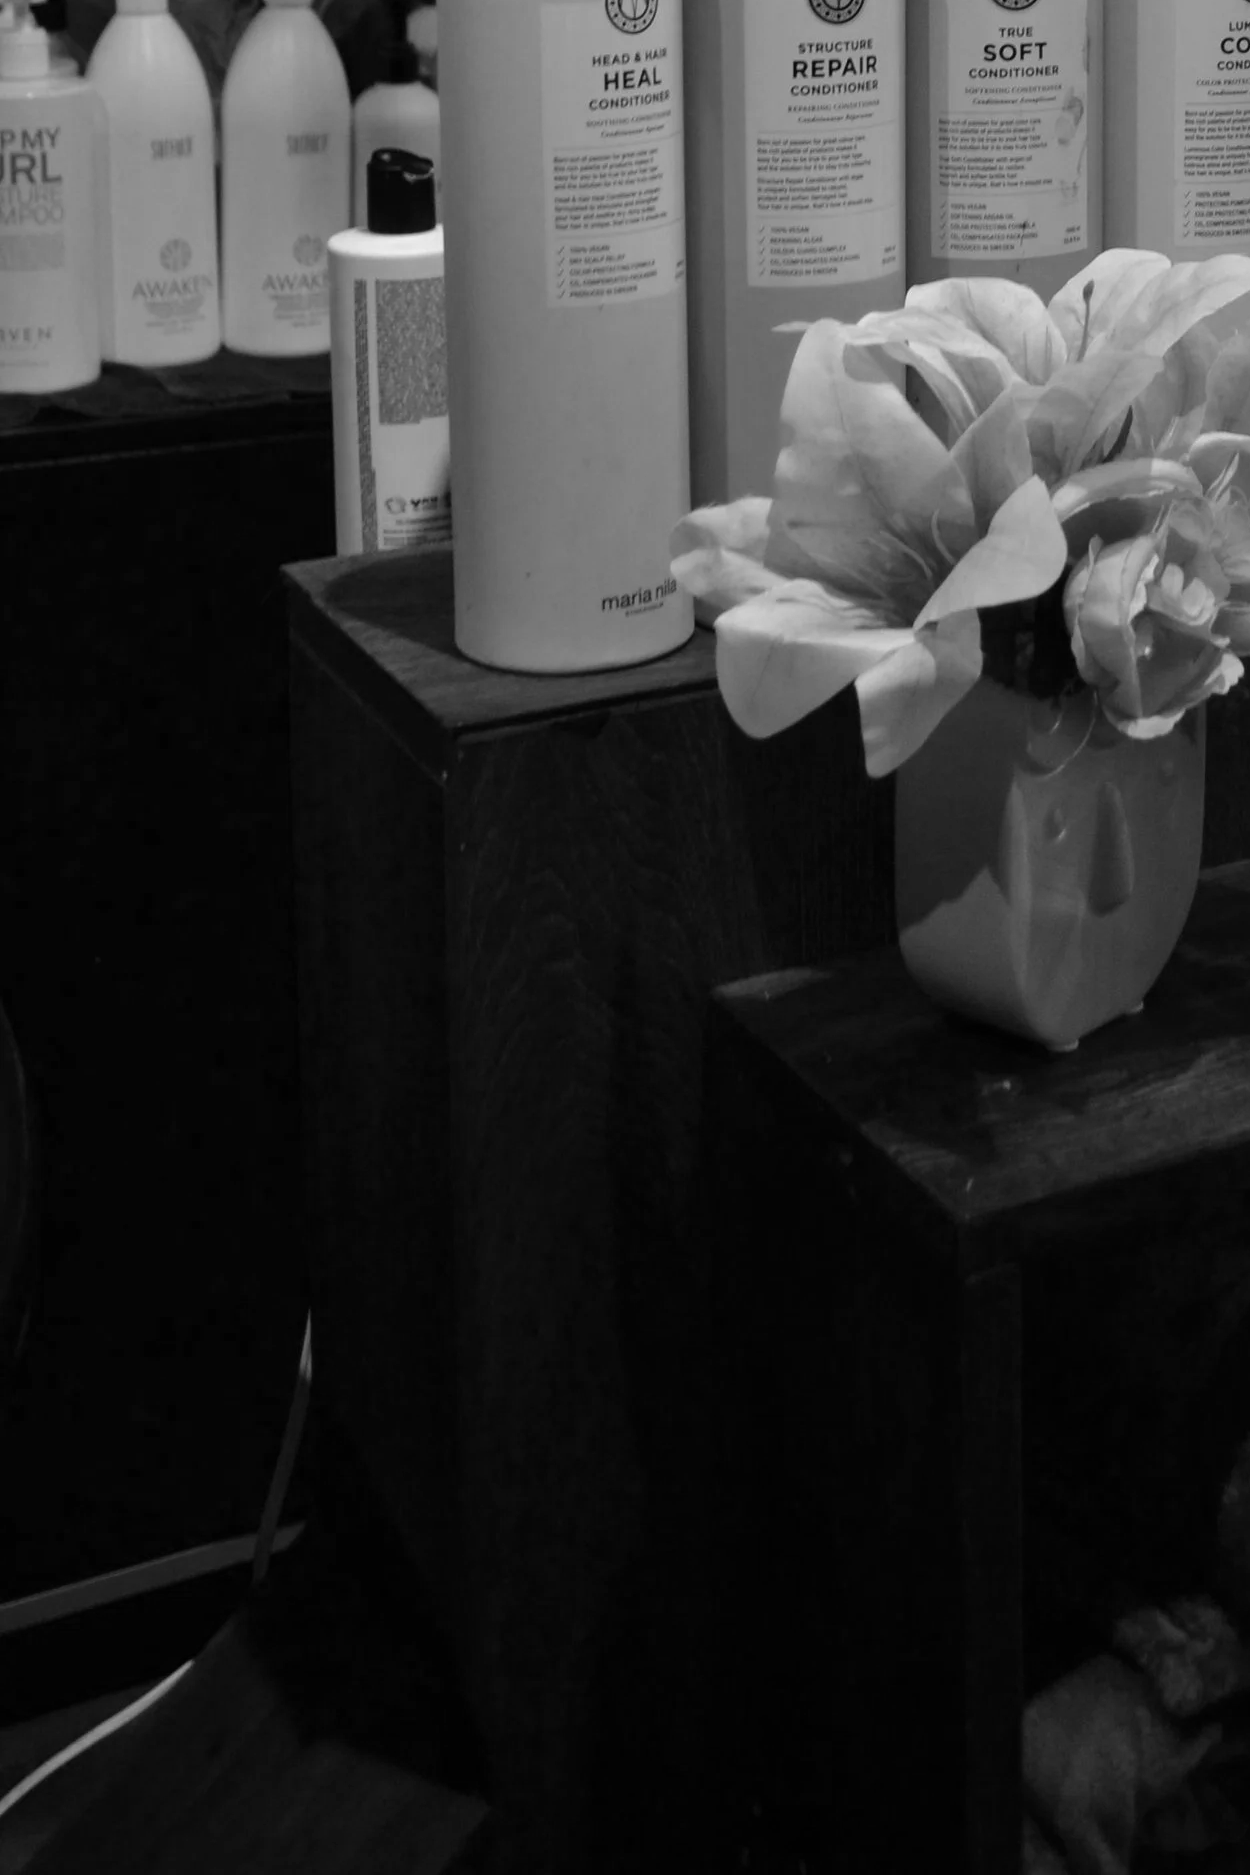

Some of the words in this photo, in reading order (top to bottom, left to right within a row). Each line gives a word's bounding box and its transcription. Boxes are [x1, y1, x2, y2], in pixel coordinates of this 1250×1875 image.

[999, 26, 1033, 38] TRUE
[798, 38, 873, 54] STRUCTURE
[983, 42, 1047, 62] SOFT
[592, 53, 630, 67] HEAD
[634, 52, 641, 63] &
[645, 47, 667, 61] HAIR
[792, 55, 877, 79] REPAIR
[604, 67, 662, 91] HEAL
[968, 65, 1059, 79] CONDITIONER
[790, 79, 879, 96] CONDITIONER
[589, 89, 670, 111] CONDITIONER
[22, 127, 61, 149] MY
[0, 153, 62, 185] RL
[602, 586, 652, 612] maria
[655, 577, 677, 601] nila
